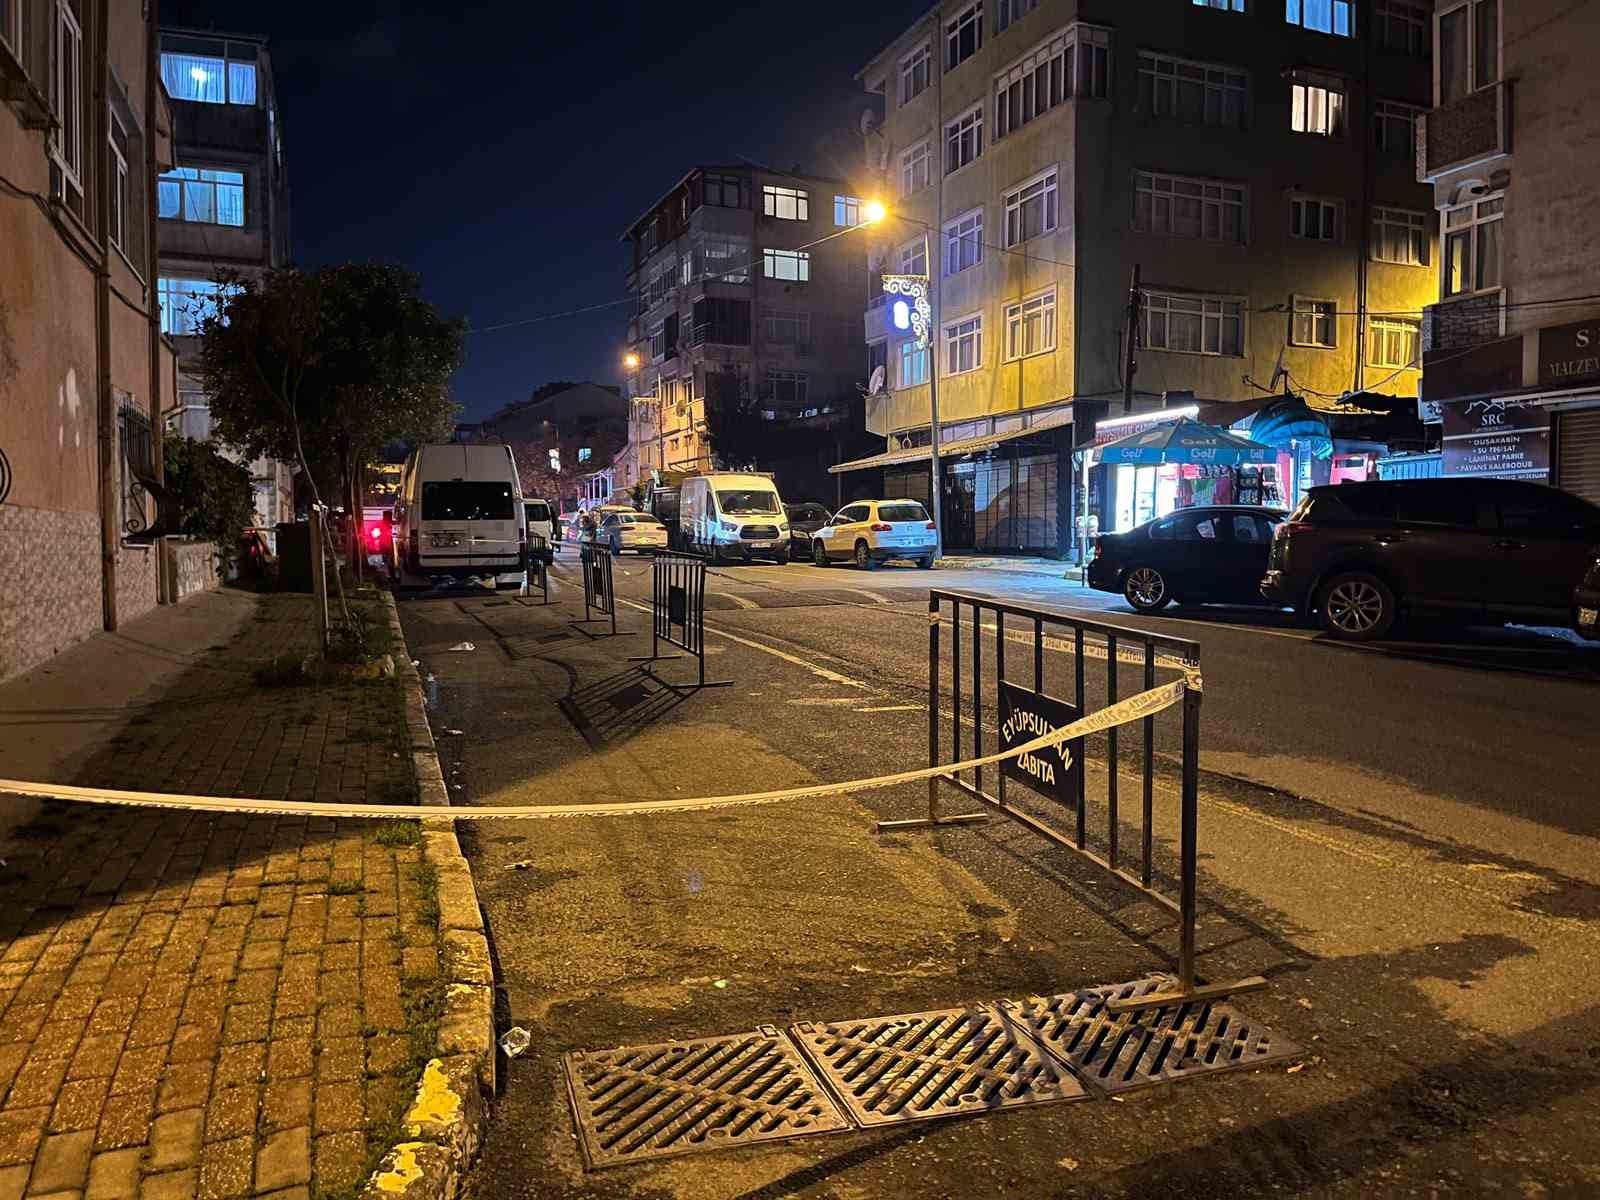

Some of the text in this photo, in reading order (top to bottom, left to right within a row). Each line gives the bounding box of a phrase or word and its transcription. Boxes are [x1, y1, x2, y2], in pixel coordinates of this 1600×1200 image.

[1575, 327, 1600, 348] S
[1481, 413, 1505, 426] SRC
[1191, 447, 1217, 459] Golf
[1018, 751, 1055, 785] ZABITA
